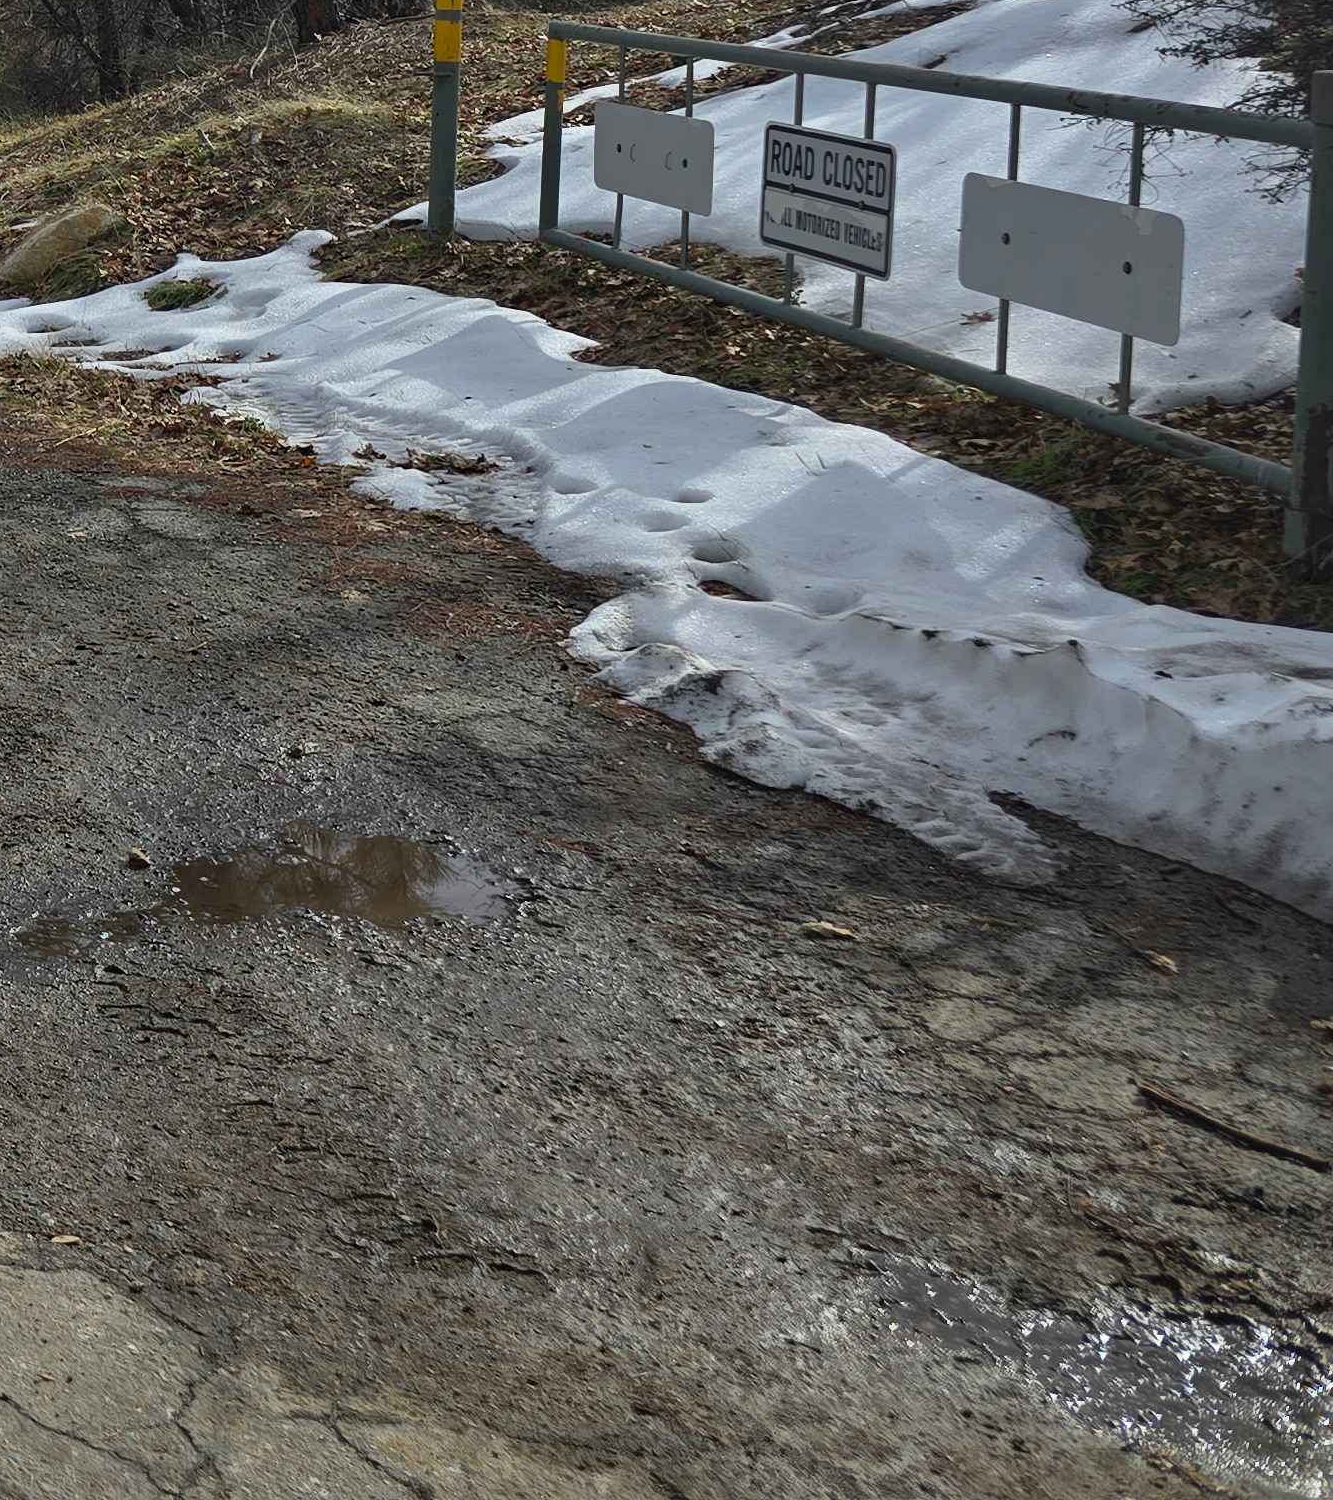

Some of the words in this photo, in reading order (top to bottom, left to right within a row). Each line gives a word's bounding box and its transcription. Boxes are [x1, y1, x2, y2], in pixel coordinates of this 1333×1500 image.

[771, 139, 815, 180] ROAD
[823, 151, 886, 198] CLOSED
[796, 210, 840, 241] MOTORIZED
[844, 222, 882, 252] VEHICLES
